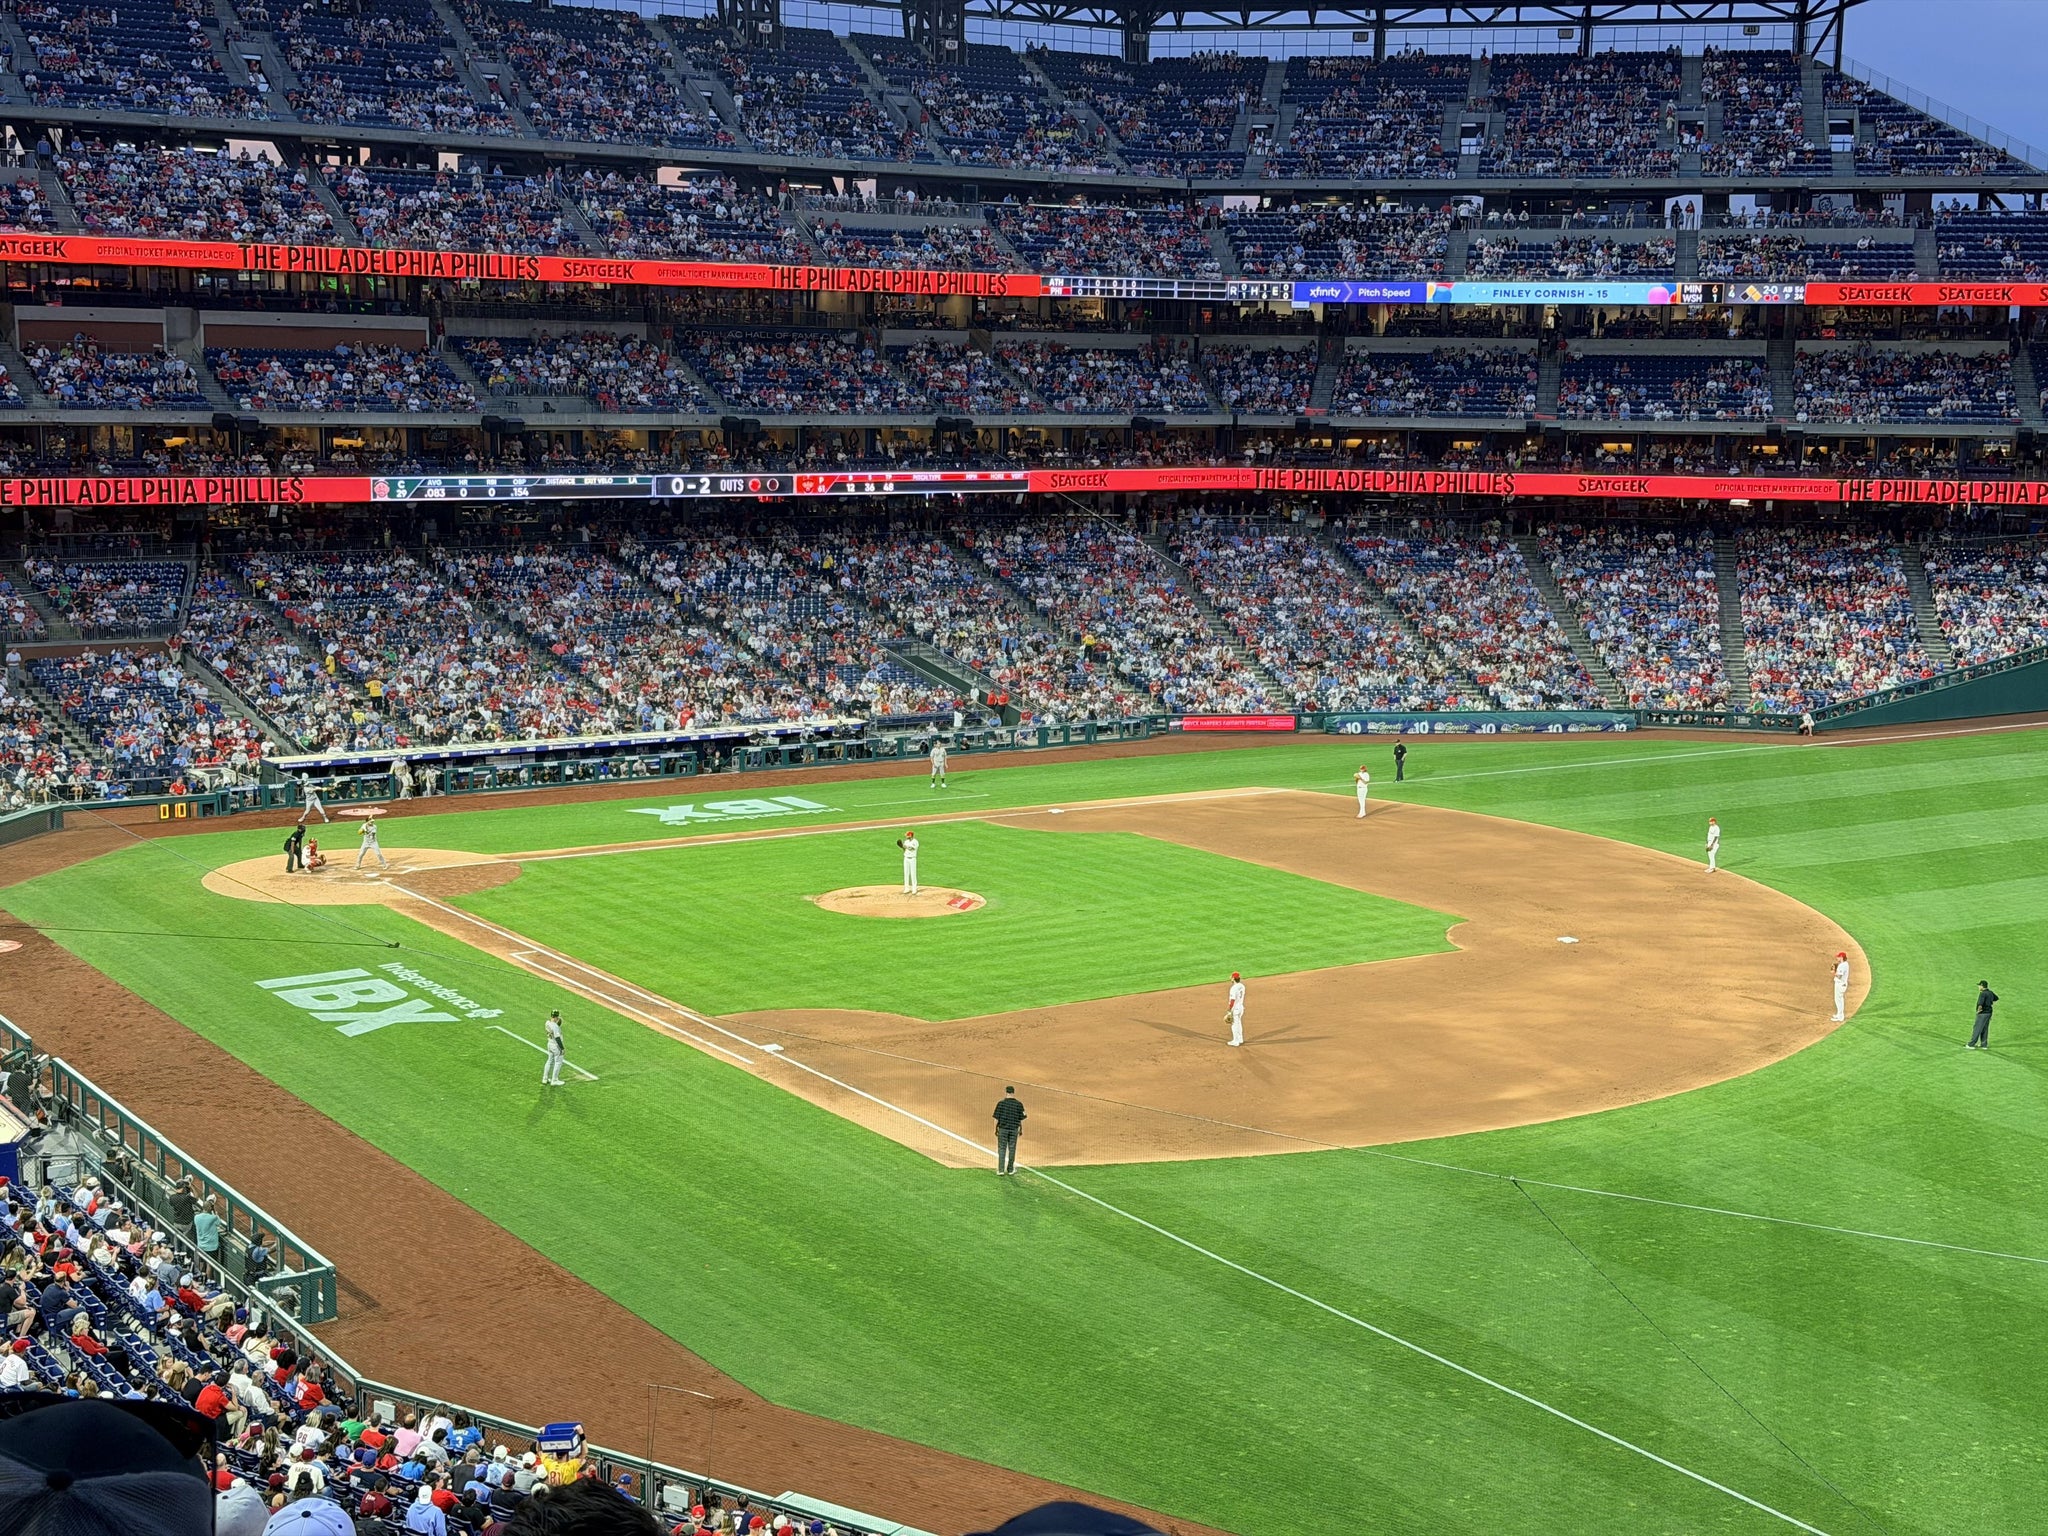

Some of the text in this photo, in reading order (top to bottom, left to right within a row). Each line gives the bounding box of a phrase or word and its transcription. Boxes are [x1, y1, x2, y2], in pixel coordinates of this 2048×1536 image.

[97, 246, 134, 256] OFFICIAL
[136, 246, 164, 258] TICKET
[166, 248, 224, 260] MARKETPLACE
[226, 251, 235, 260] OF
[238, 245, 281, 270] THE
[288, 246, 444, 276] PHILADELPHIA
[563, 261, 634, 280] SEATGEEK
[768, 266, 801, 288] THE
[806, 268, 931, 293] PHILADELPHIA
[1049, 278, 1064, 286] ATH
[1050, 287, 1062, 295] PHI
[1230, 286, 1278, 296] R H E
[1262, 291, 1267, 299] 6
[1310, 287, 1410, 298] xfinity Pitch Speed
[1535, 290, 1584, 298] CORNISH
[1599, 290, 1608, 298] 15
[1684, 285, 1718, 293] MIN 6
[1728, 290, 1735, 298] 4
[1763, 286, 1778, 294] 2-0
[1838, 286, 1913, 301] SEATGEEK
[1938, 286, 2014, 301] SEATGEEK
[1713, 294, 1717, 302] 1
[720, 480, 744, 492] OUTS
[1050, 472, 1108, 488] SEATGEEK
[1252, 469, 1287, 489] THE
[1292, 470, 1427, 492] PHILADELPHIA
[1577, 478, 1649, 493] SEATGEEK
[20, 479, 198, 504] PHILADELPHIA
[396, 487, 529, 498] 29 .083 0 0 .154
[847, 483, 855, 492] 12
[865, 483, 875, 492] 36
[883, 483, 894, 491] 48
[1836, 480, 1875, 501] THE
[1880, 481, 2029, 503] PHILADELPHIA
[1346, 722, 1361, 734] 10
[1414, 721, 1429, 734] 10
[1481, 723, 1496, 734] 10
[1548, 724, 1562, 733] 10
[160, 803, 187, 819] 0 10
[378, 962, 479, 1010] Independence
[254, 968, 462, 1037] IBX
[456, 1437, 463, 1448] 3
